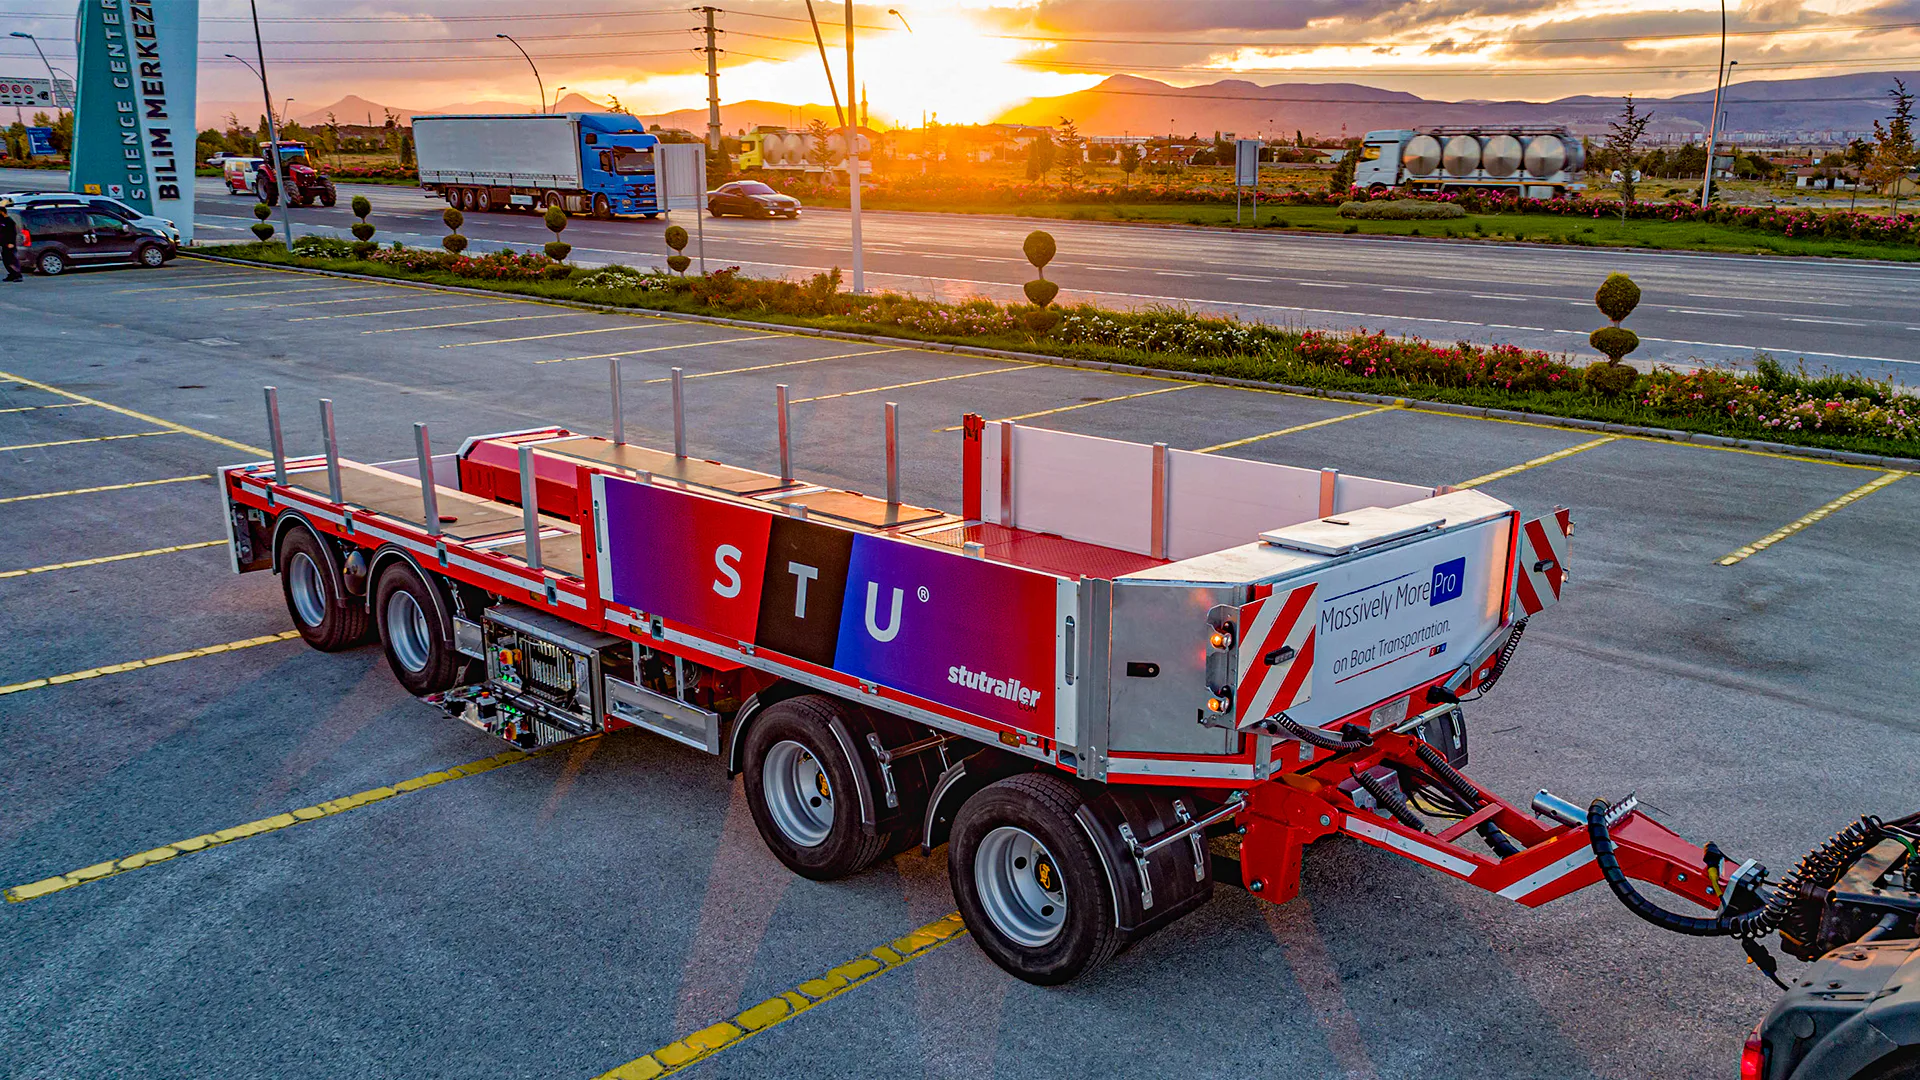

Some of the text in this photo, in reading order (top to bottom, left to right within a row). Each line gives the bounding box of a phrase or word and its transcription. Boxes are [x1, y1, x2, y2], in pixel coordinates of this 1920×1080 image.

[101, 0, 129, 88] CENTER
[117, 101, 146, 200] SCIENCE
[149, 128, 180, 200] BİLİM
[1320, 590, 1393, 635] Massively
[1333, 620, 1451, 674] on Boat Transportation.
[947, 665, 1041, 707] stutrailer
